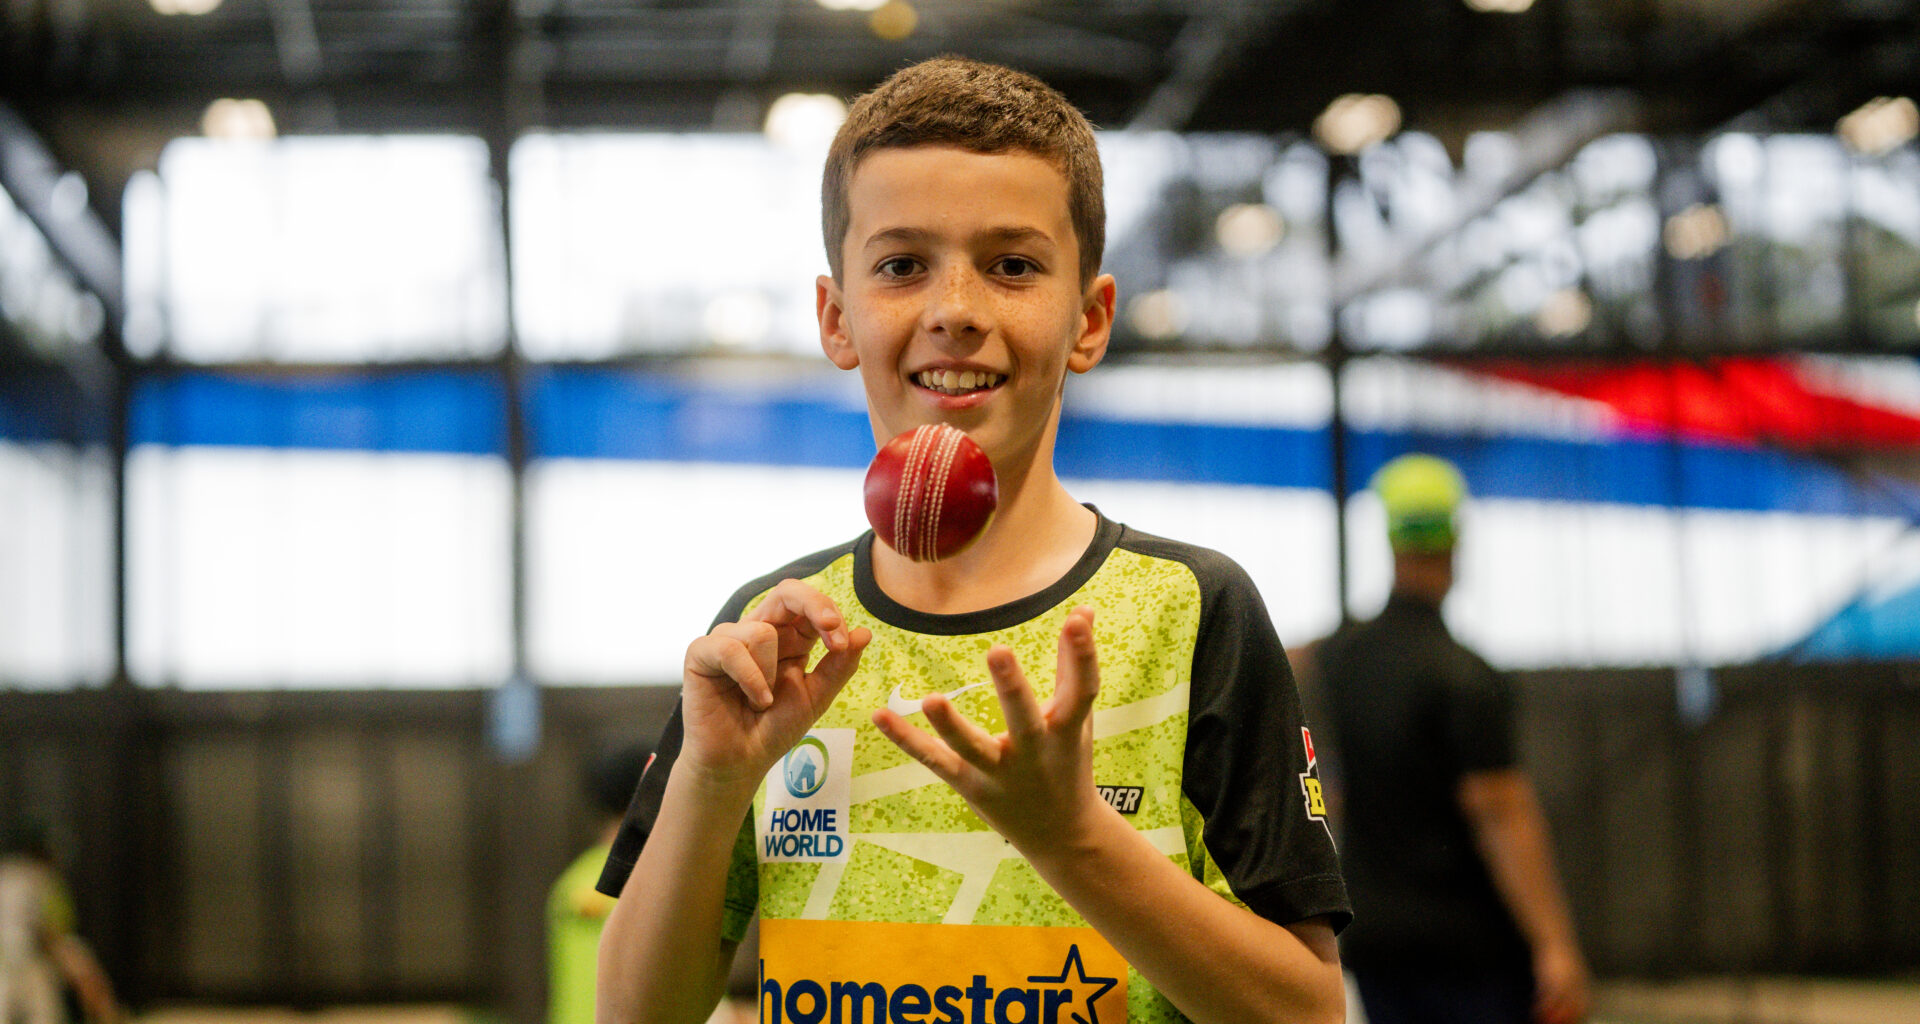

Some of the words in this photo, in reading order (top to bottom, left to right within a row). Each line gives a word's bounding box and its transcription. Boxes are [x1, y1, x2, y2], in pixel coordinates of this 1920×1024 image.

[1096, 787, 1141, 811] DER
[770, 808, 837, 832] HOME
[765, 834, 844, 857] WORLD
[759, 958, 1073, 1024] homestar
